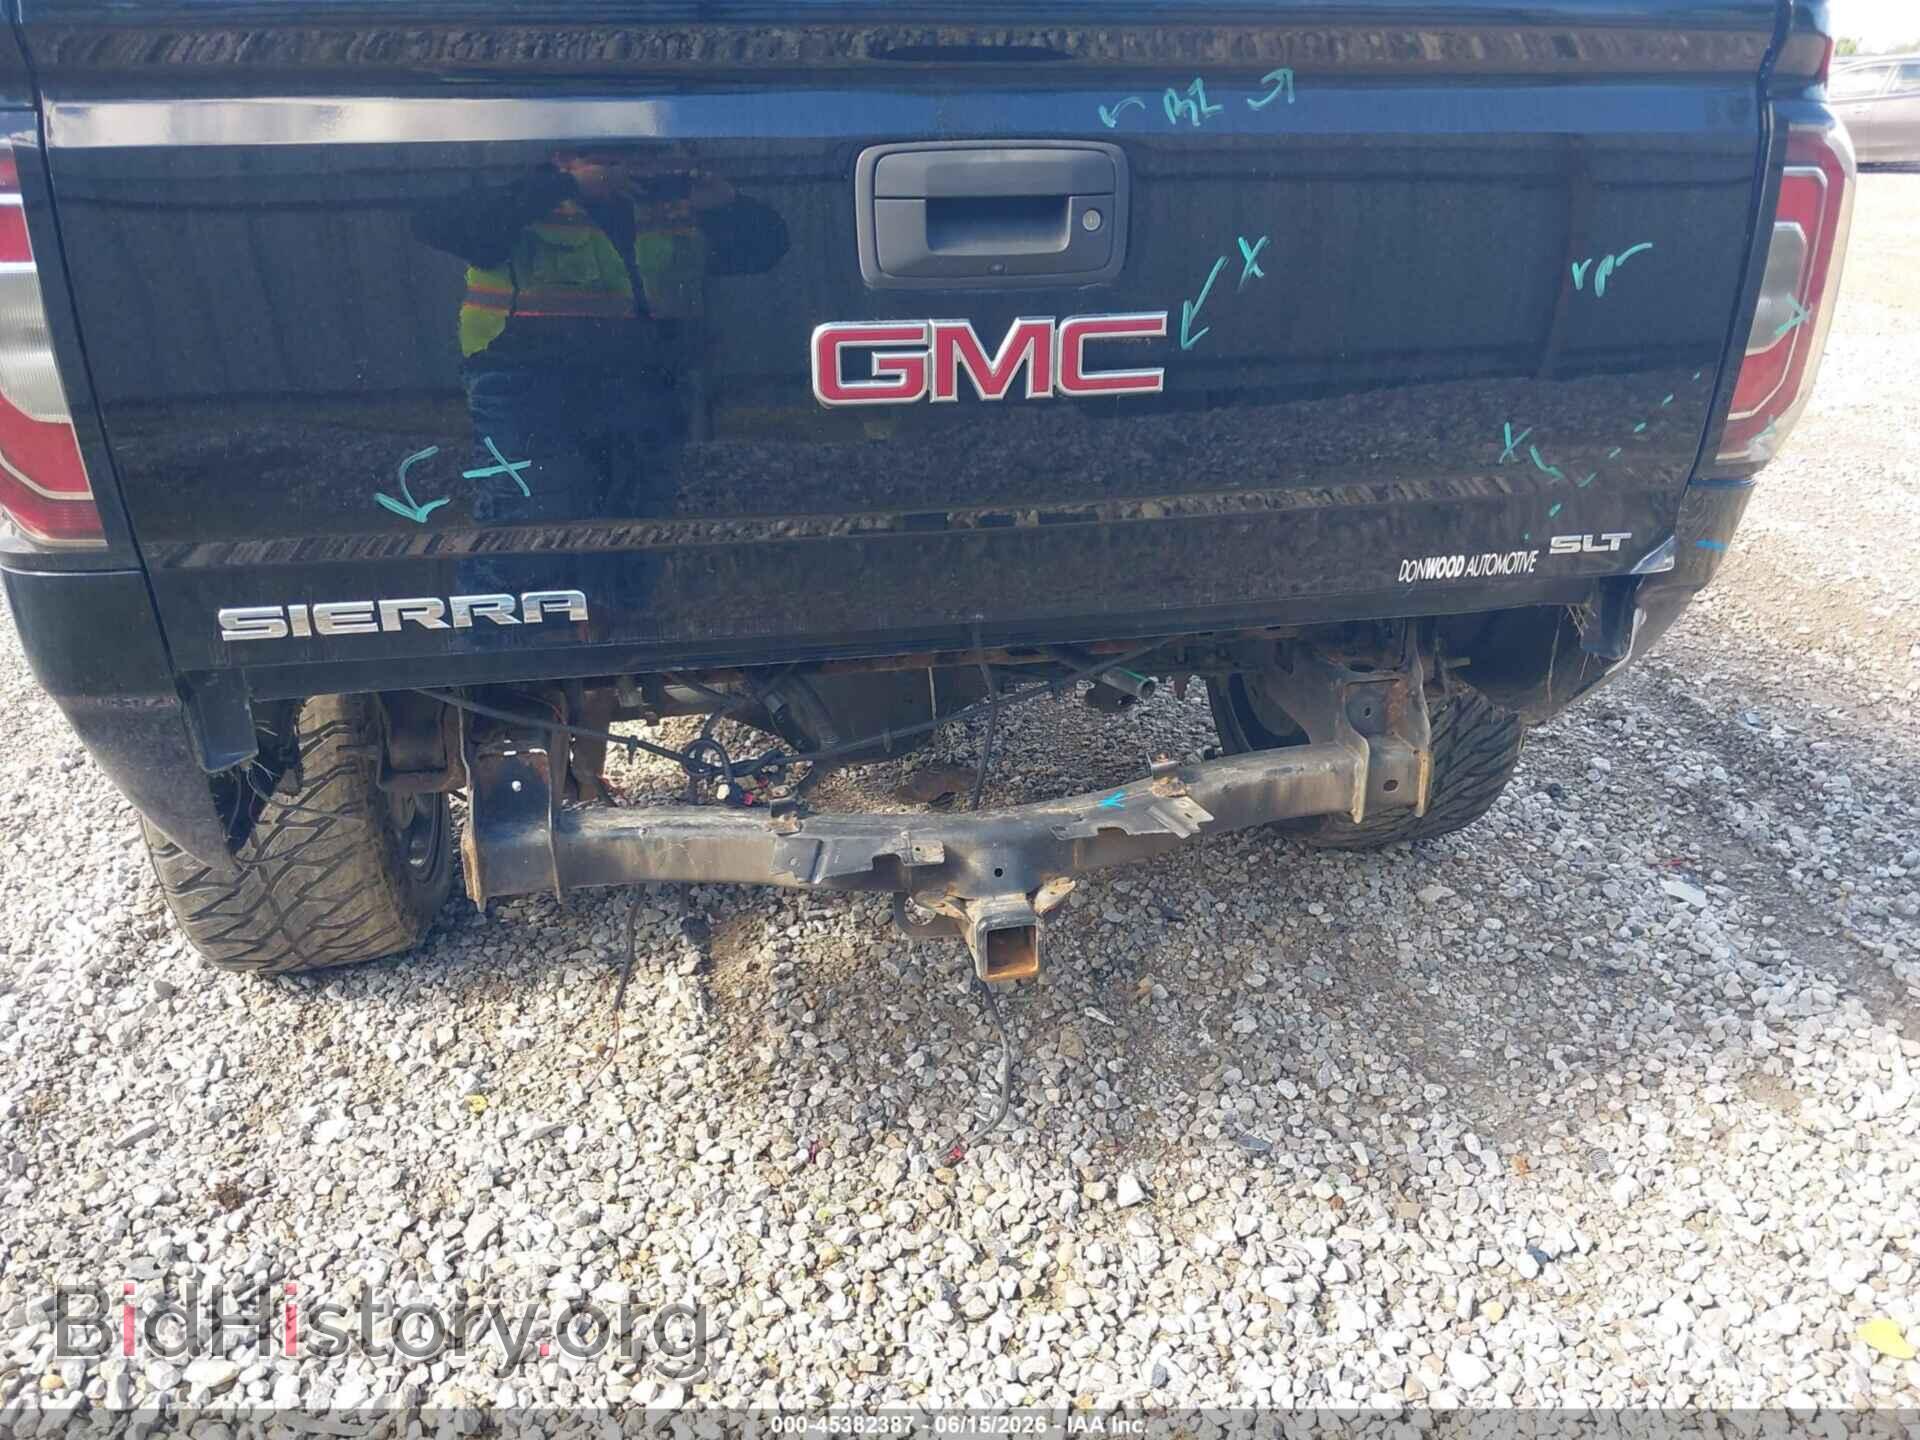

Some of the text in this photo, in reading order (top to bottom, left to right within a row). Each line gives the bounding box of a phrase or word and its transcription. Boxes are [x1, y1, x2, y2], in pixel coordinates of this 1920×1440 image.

[810, 310, 1169, 409] GMC
[1549, 533, 1632, 555] SLT
[1397, 549, 1540, 583] DONWOOD AUTOMOTIVE
[218, 589, 590, 641] SIERRA
